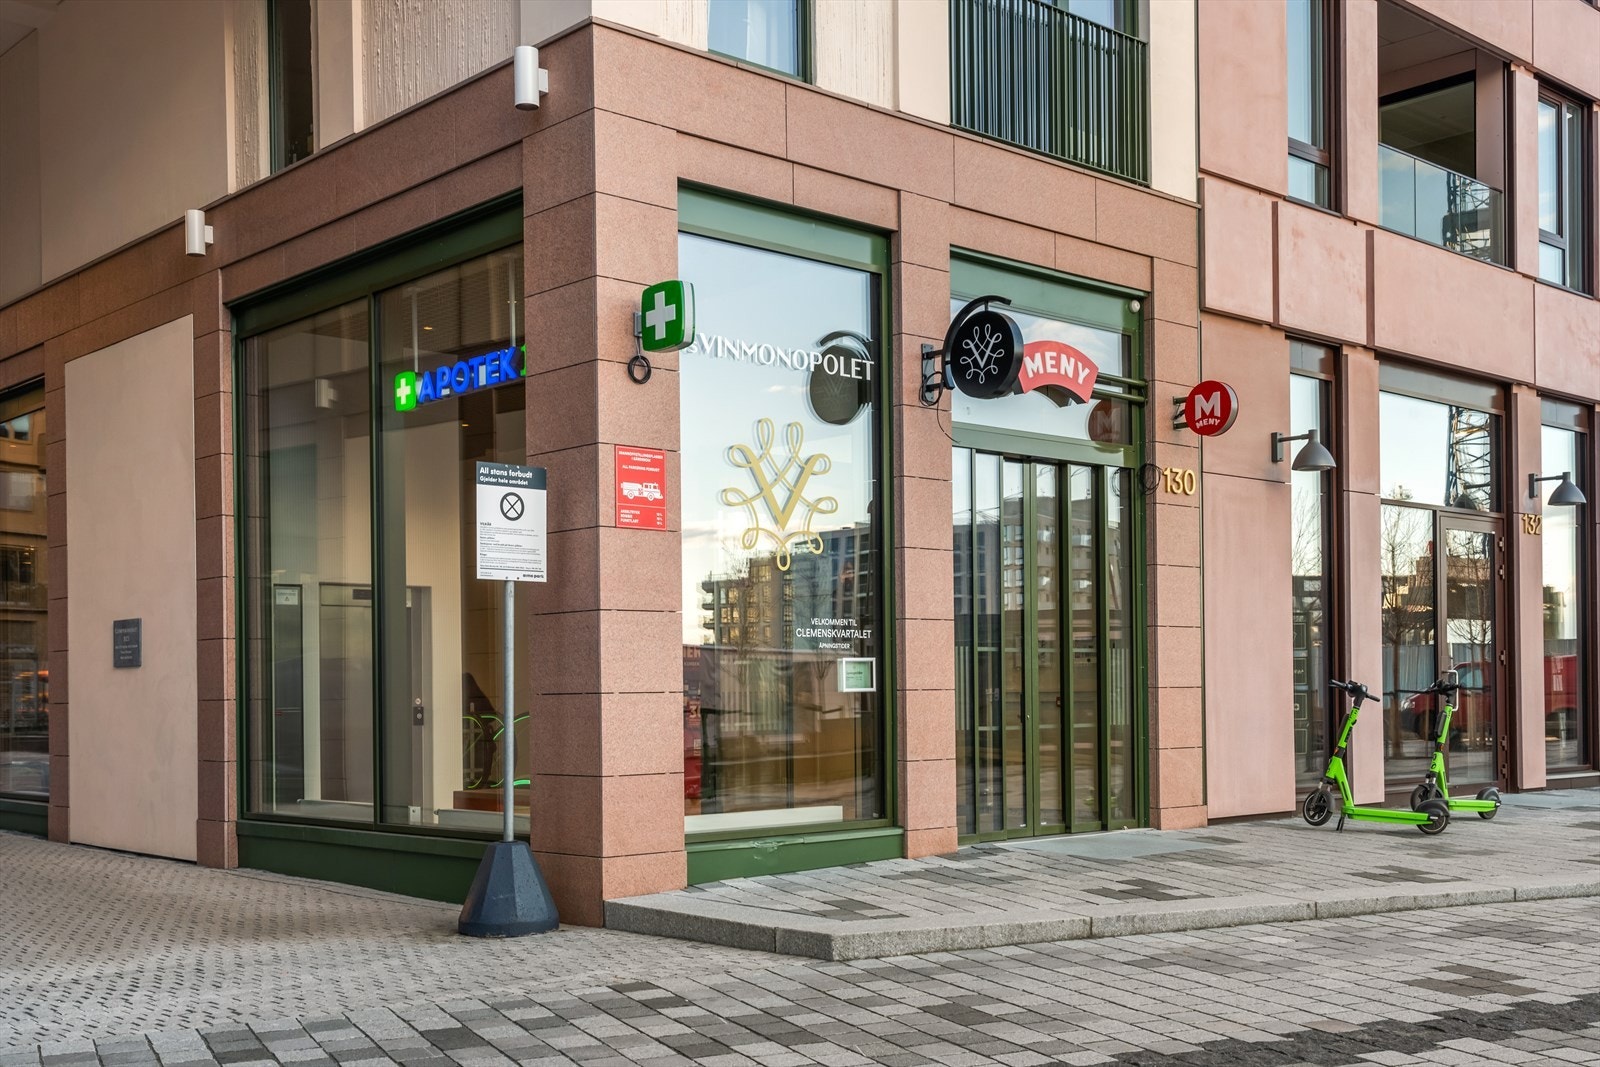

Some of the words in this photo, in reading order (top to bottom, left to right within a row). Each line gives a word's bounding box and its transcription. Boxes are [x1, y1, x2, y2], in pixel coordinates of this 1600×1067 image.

[699, 333, 875, 380] VINMONOPOLET
[418, 346, 518, 403] APOTEK
[1024, 351, 1090, 385] MENY
[1194, 391, 1220, 421] M
[1195, 418, 1220, 429] MENY
[509, 469, 533, 479] forbudt
[1163, 466, 1196, 495] 130
[1521, 513, 1542, 535] 132
[810, 617, 848, 627] VELKOMMEN
[849, 619, 857, 627] TIL
[795, 628, 872, 639] CLEMENSKVARTALET
[819, 641, 851, 649] ÅPNINGSTIDER
